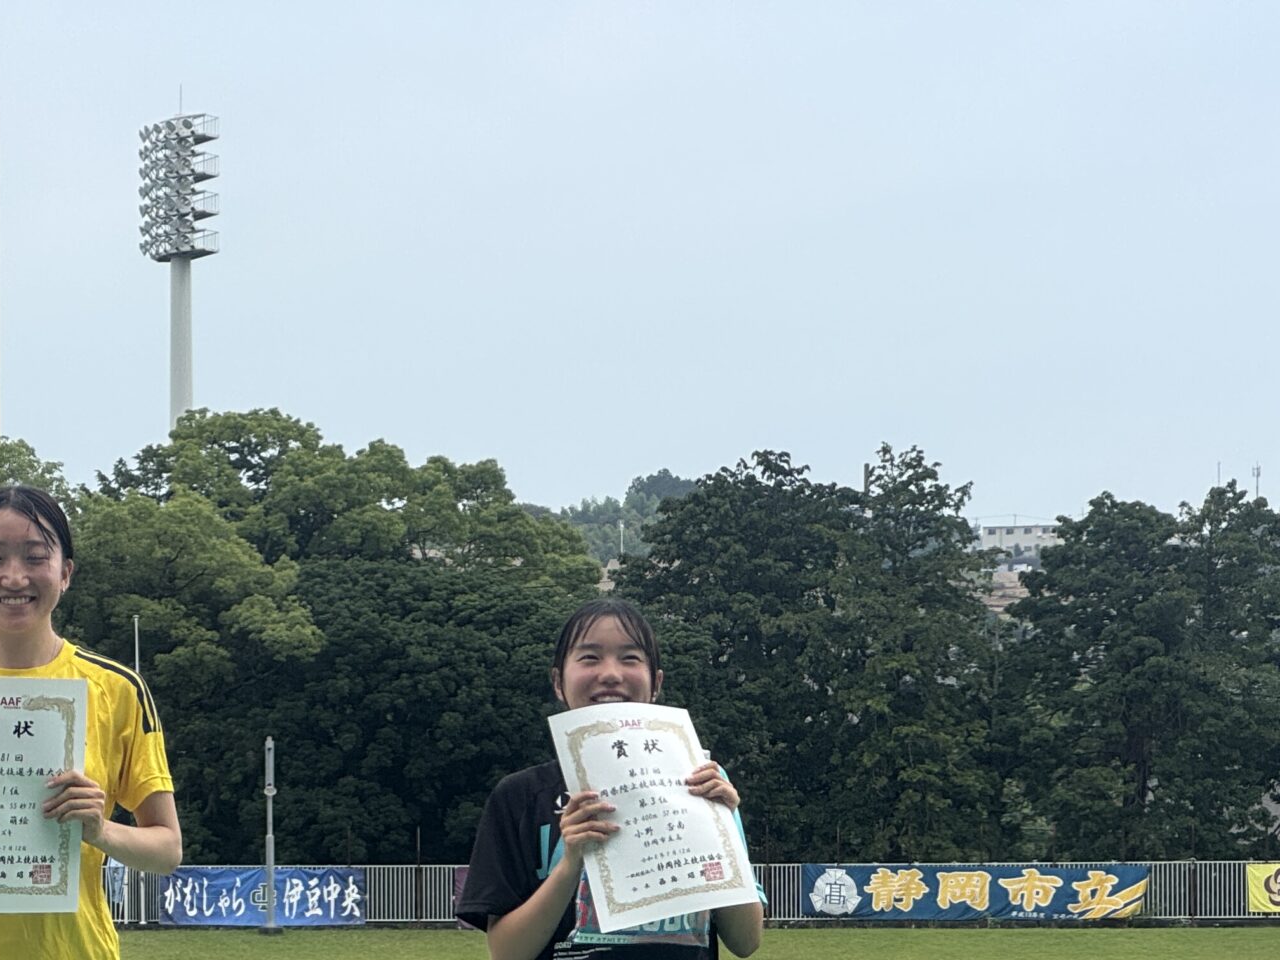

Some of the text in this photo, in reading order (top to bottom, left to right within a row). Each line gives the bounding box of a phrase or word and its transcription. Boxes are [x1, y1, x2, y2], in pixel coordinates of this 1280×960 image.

[618, 719, 642, 728] JAAF
[164, 876, 246, 917] がむしゃら
[283, 875, 361, 919] 伊豆中央
[863, 868, 1127, 912] 静岡市立
